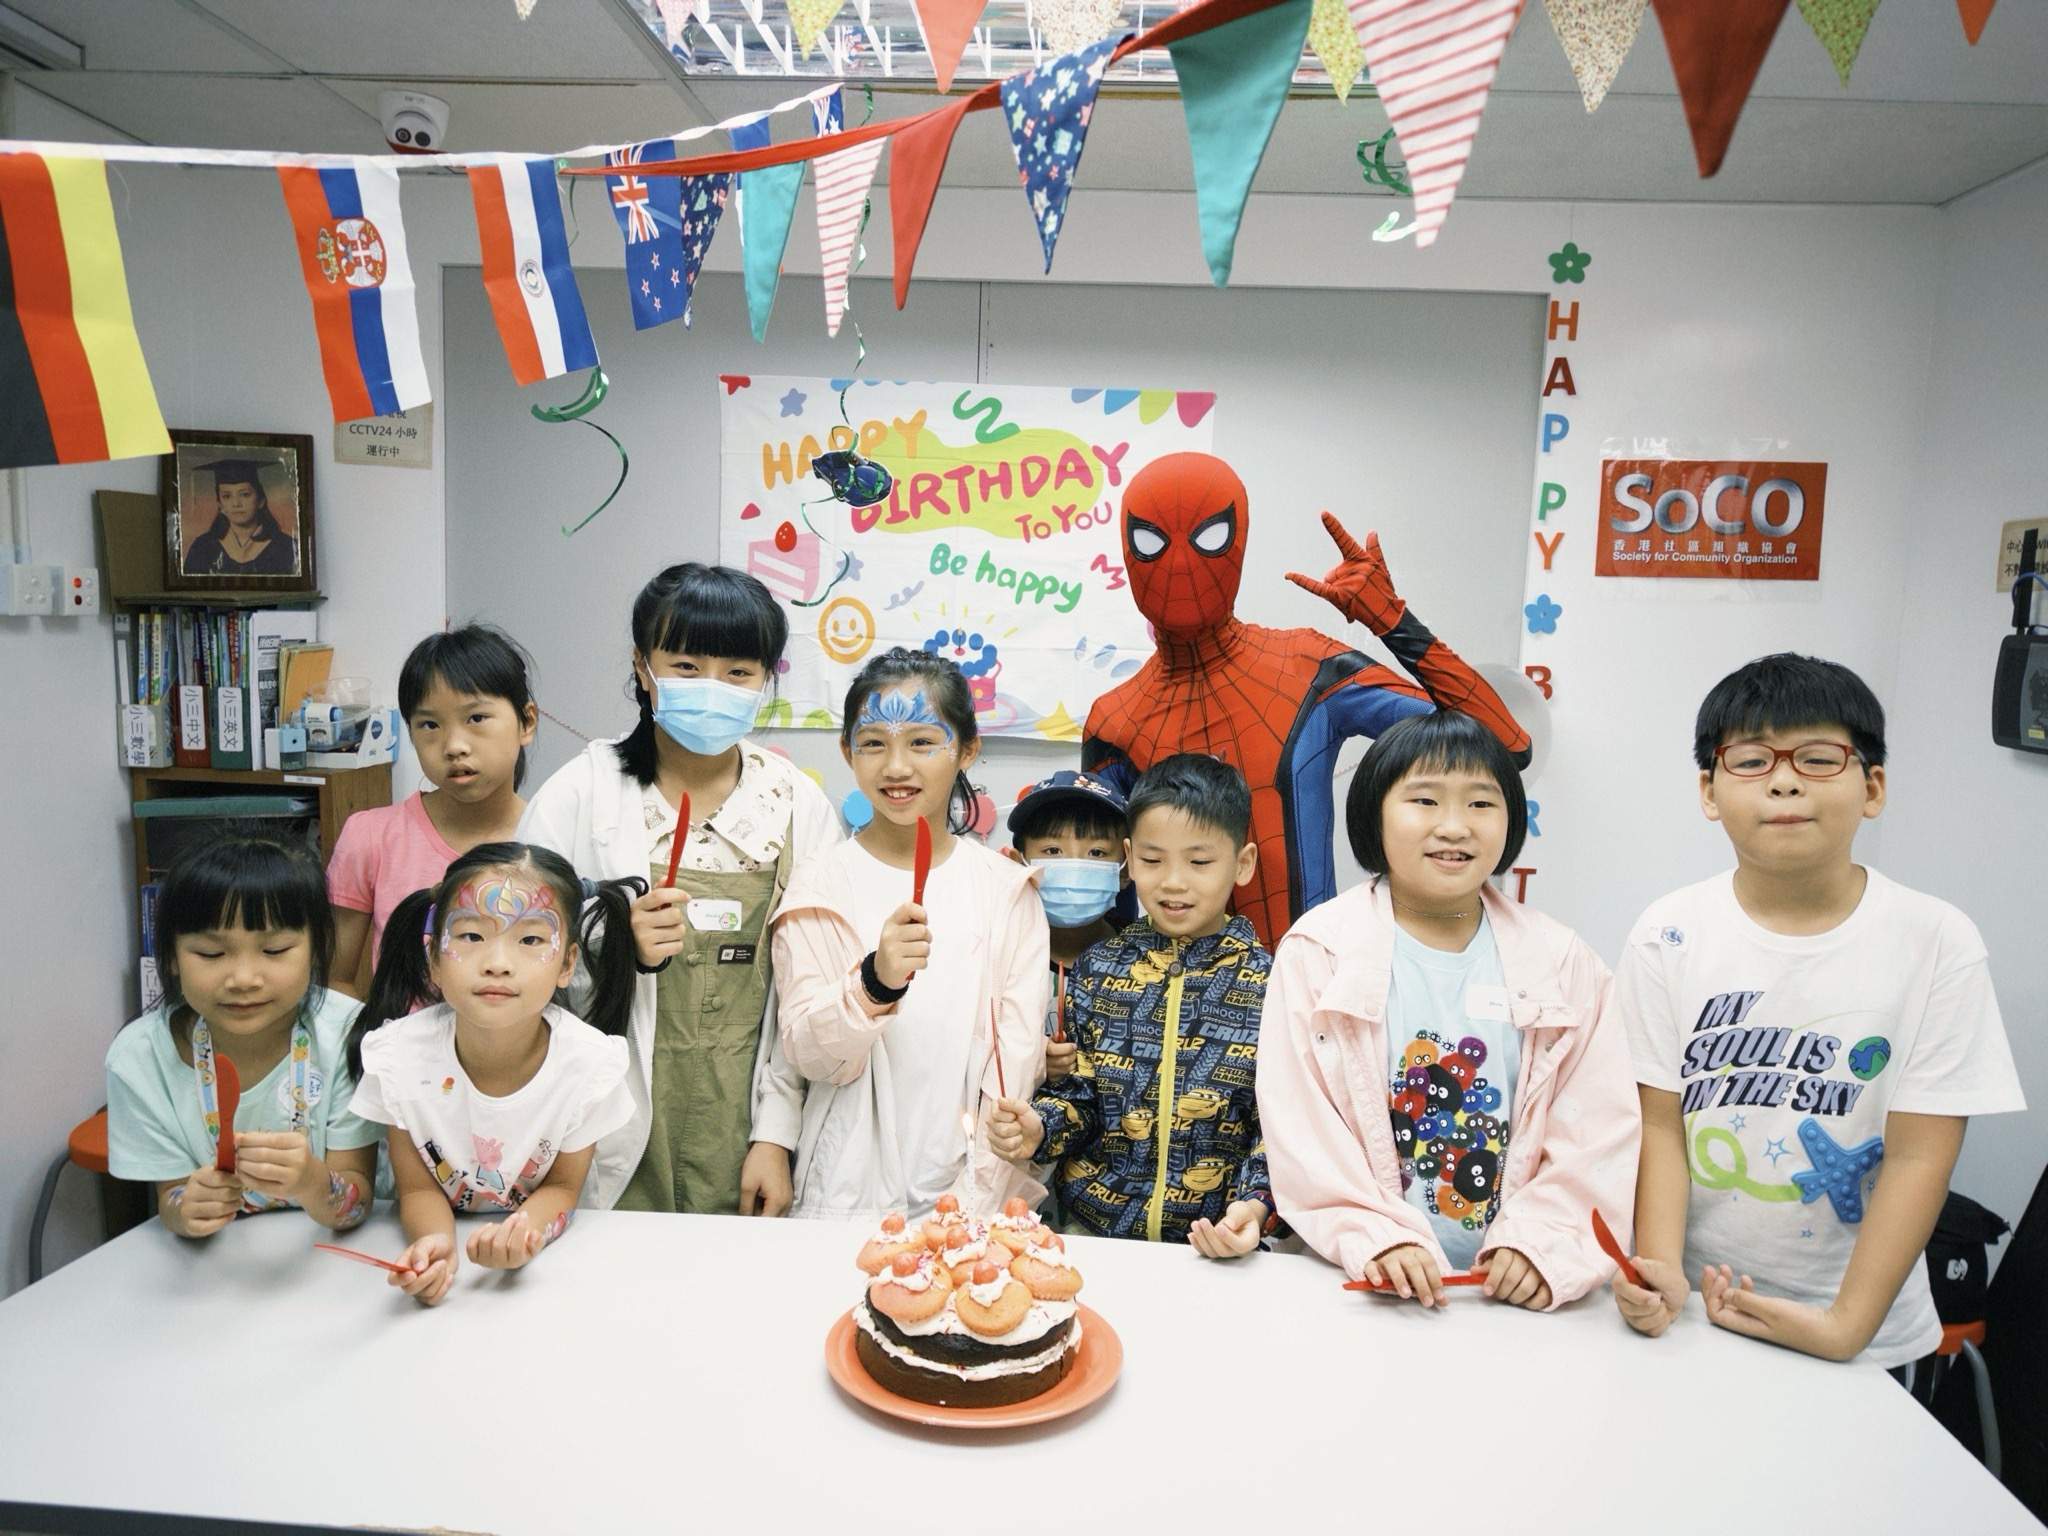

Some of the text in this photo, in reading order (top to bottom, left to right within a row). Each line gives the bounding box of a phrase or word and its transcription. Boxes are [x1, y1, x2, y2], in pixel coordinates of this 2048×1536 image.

[349, 424, 417, 439] CCTV24 小時
[1534, 300, 1580, 571] HAPPY
[366, 445, 400, 458] 運行中
[1613, 551, 1798, 566] Society for Community Organization
[929, 543, 1083, 614] Be happy
[184, 688, 201, 746] 小三中文
[222, 689, 239, 748] 小三英文
[1102, 976, 1146, 993] CRUZ
[1201, 1004, 1244, 1021] DINOCO
[1693, 991, 1765, 1033] MY
[1131, 1024, 1162, 1037] DINOC
[1199, 1022, 1259, 1045] CRUZ
[1681, 1027, 1842, 1078] SOUL IS
[1683, 1072, 1864, 1116] IN THE SKY
[1086, 1182, 1130, 1205] CRUZ
[1164, 1188, 1205, 1203] RUZ
